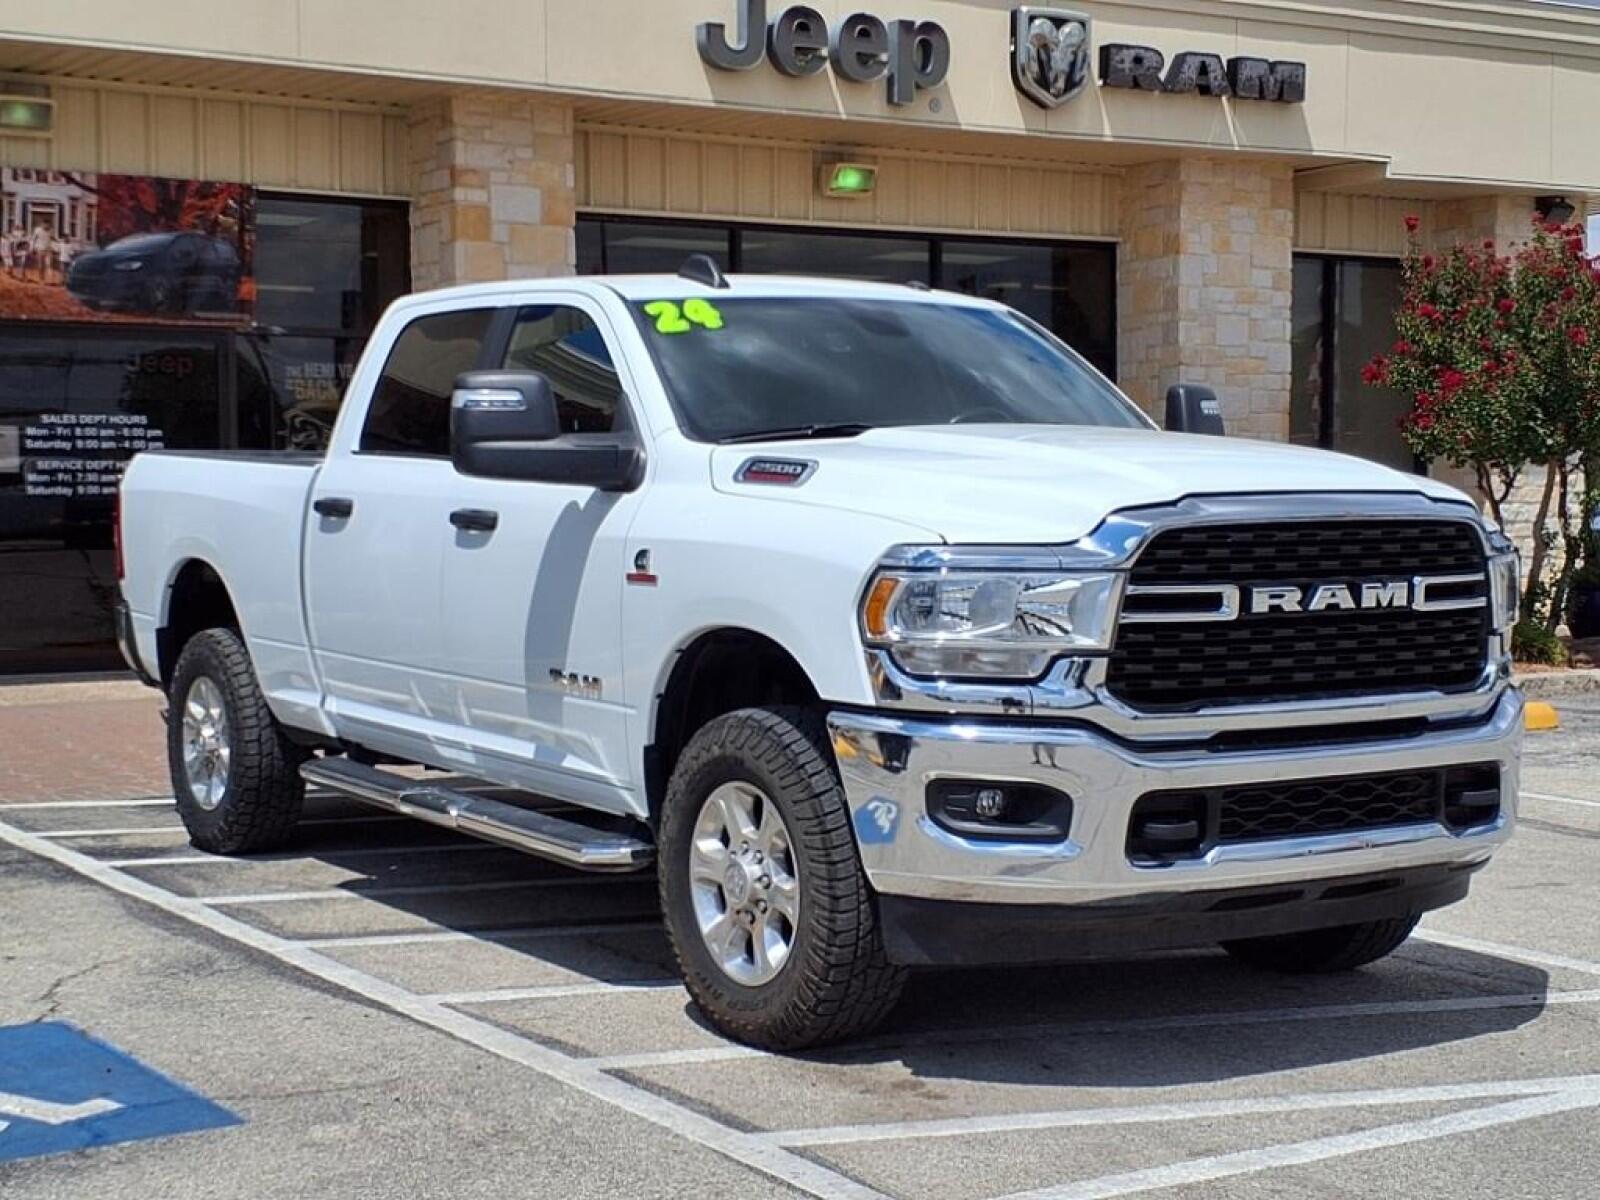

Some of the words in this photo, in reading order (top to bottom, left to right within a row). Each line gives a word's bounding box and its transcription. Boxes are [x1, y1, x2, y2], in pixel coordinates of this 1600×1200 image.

[697, 0, 951, 105] Jeep
[1099, 44, 1306, 102] RAM
[41, 415, 77, 424] SALES
[79, 415, 109, 424] DEPT
[110, 416, 148, 425] HOURS
[26, 427, 49, 436] Mon
[57, 428, 72, 436] Fri
[100, 429, 115, 437] am
[147, 429, 163, 438] pm
[25, 439, 73, 450] Saturday
[101, 441, 116, 449] am
[37, 461, 83, 470] SERVICE
[86, 461, 114, 470] DEPT
[749, 461, 803, 475] 2500
[27, 473, 50, 482] Mon
[58, 473, 72, 482] Fri
[27, 485, 74, 497] Saturday
[1251, 583, 1409, 613] RAM
